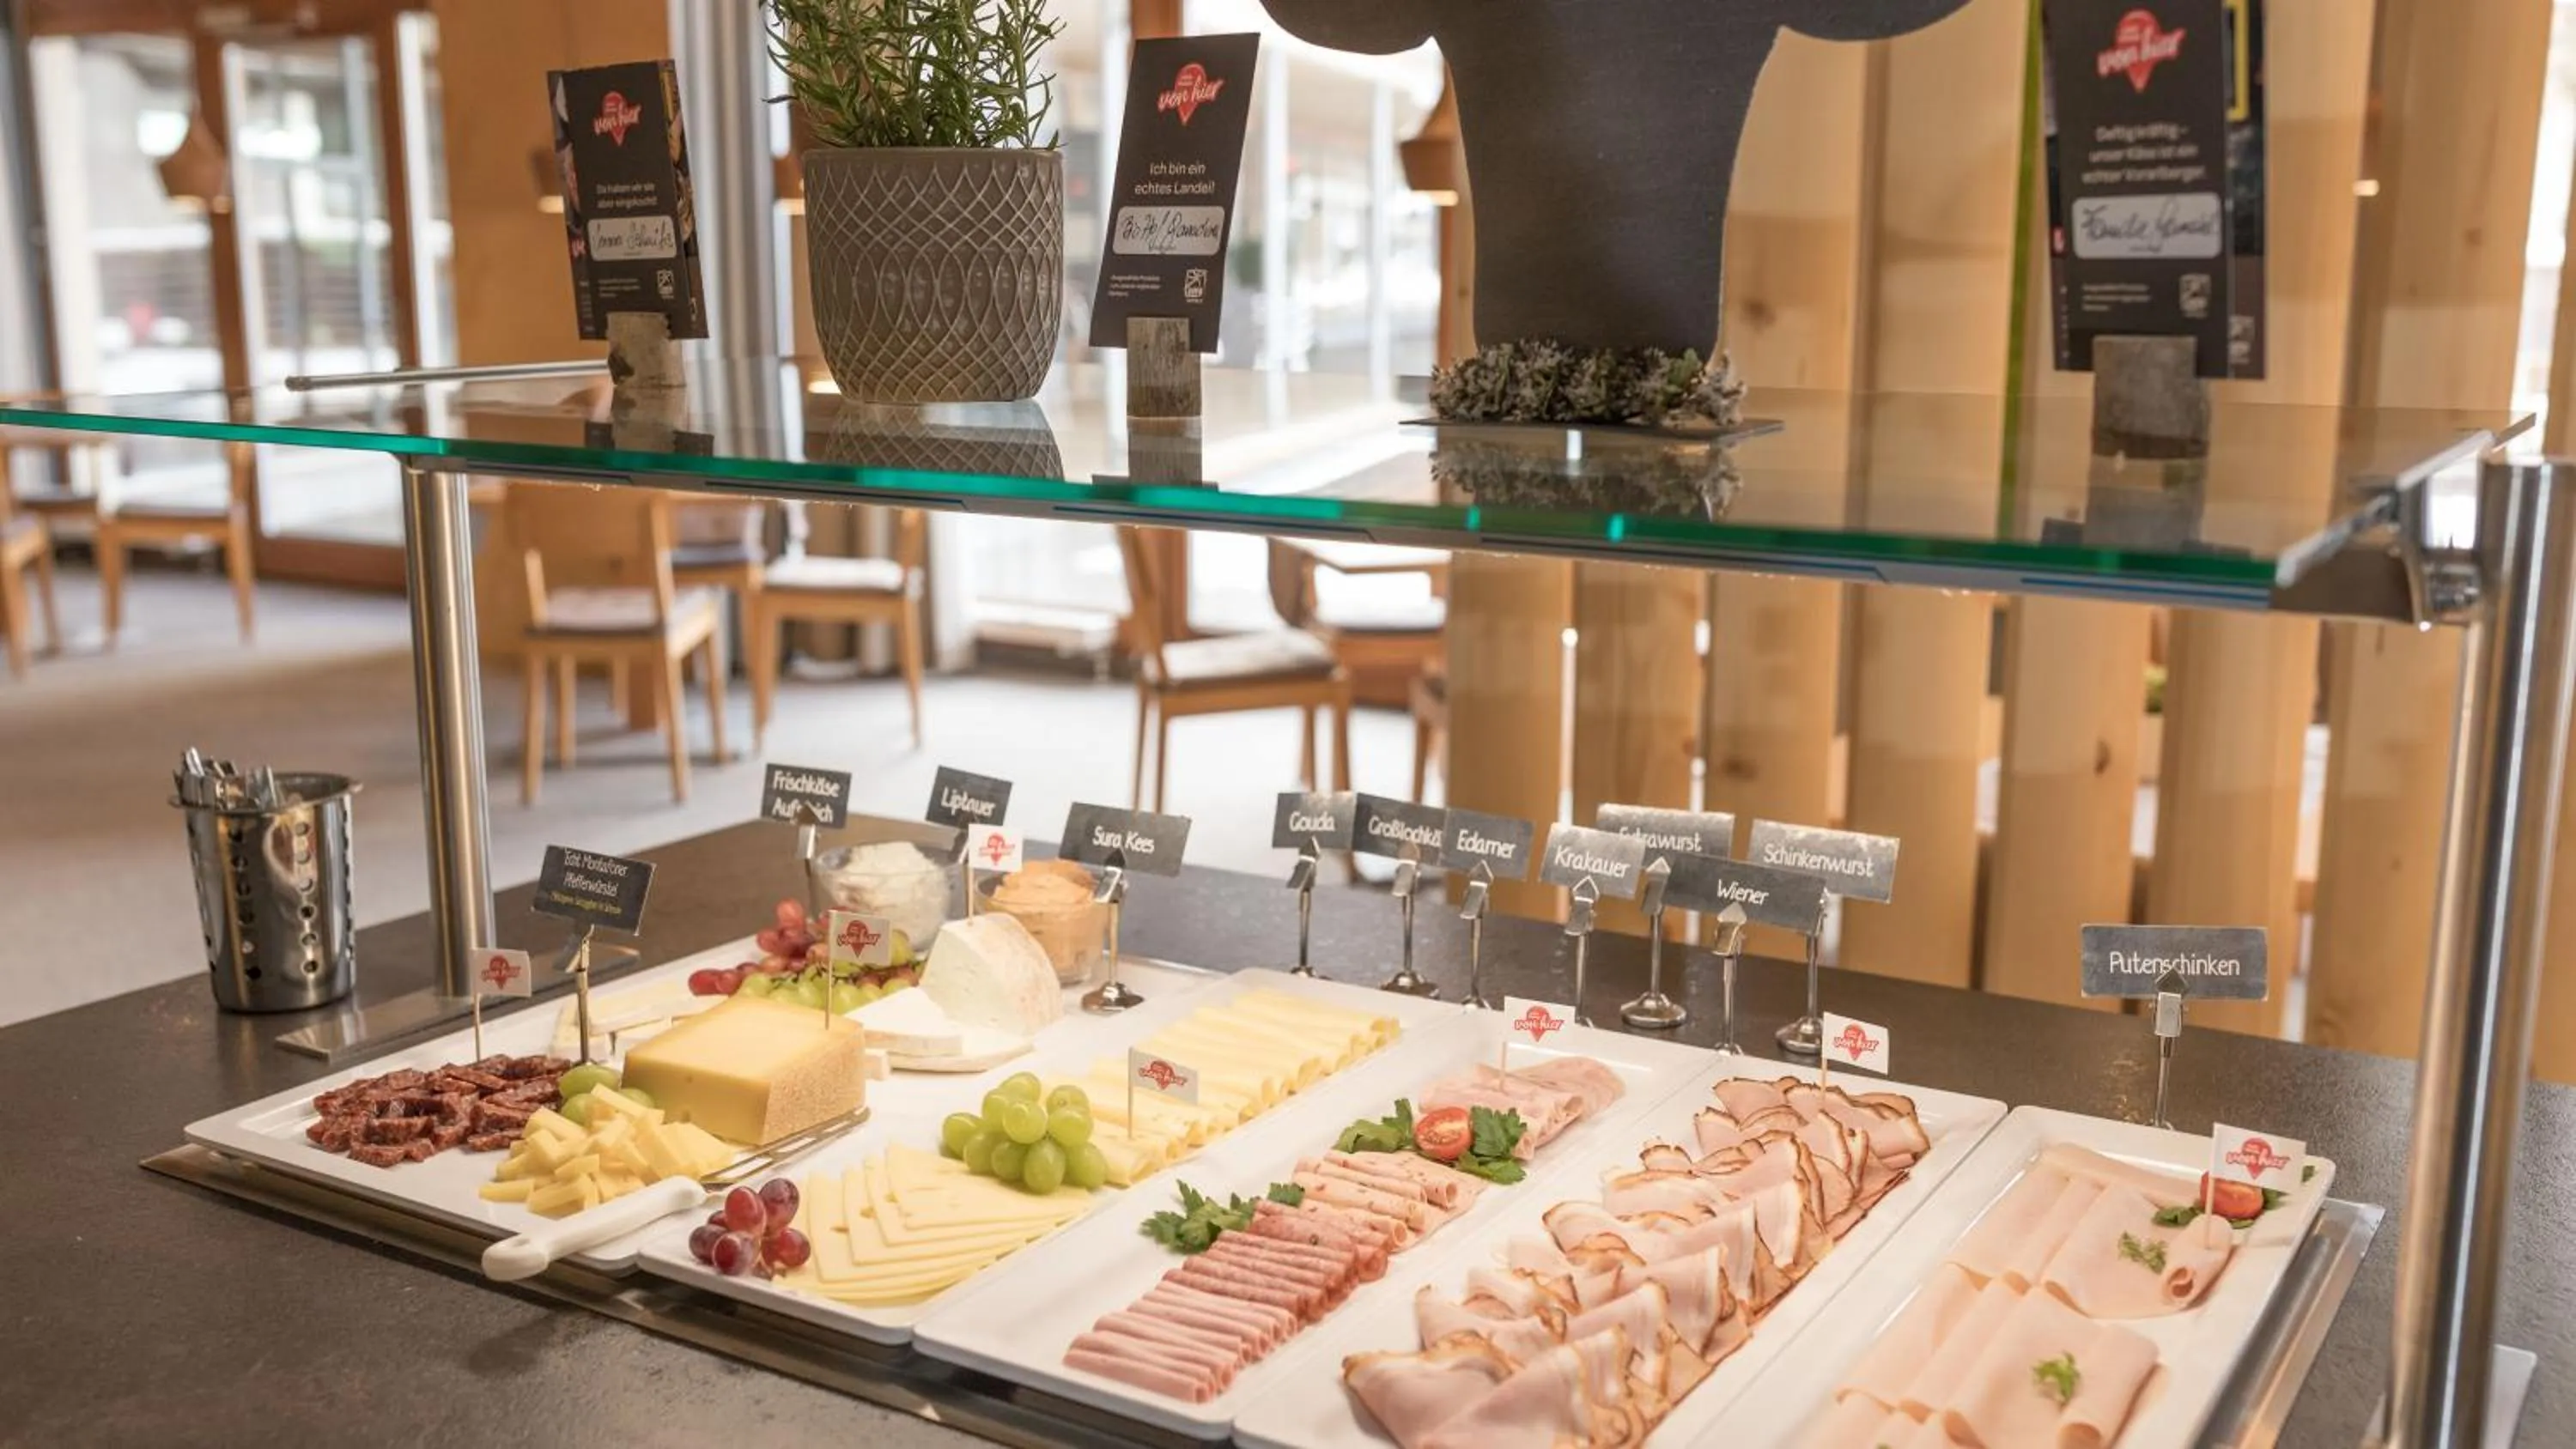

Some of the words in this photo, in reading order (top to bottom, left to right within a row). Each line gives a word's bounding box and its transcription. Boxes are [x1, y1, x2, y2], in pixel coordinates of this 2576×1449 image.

[1150, 161, 1167, 175] Ich
[1169, 161, 1186, 175] bin
[1188, 161, 1206, 175] ein
[1134, 181, 1172, 196] echtes
[773, 769, 841, 797] Frischkäse
[940, 785, 997, 818] Liptauer
[1289, 810, 1335, 833] Gouda
[1368, 815, 1443, 848] Großlochkä
[1091, 825, 1123, 849] Sura
[1124, 829, 1156, 855] Kees
[1456, 828, 1517, 859] Edamer
[1553, 845, 1631, 879] Krakauer
[1762, 842, 1875, 878] Schinkenwurst
[1716, 877, 1771, 906] Wiener
[2109, 949, 2241, 977] Putenschinken
